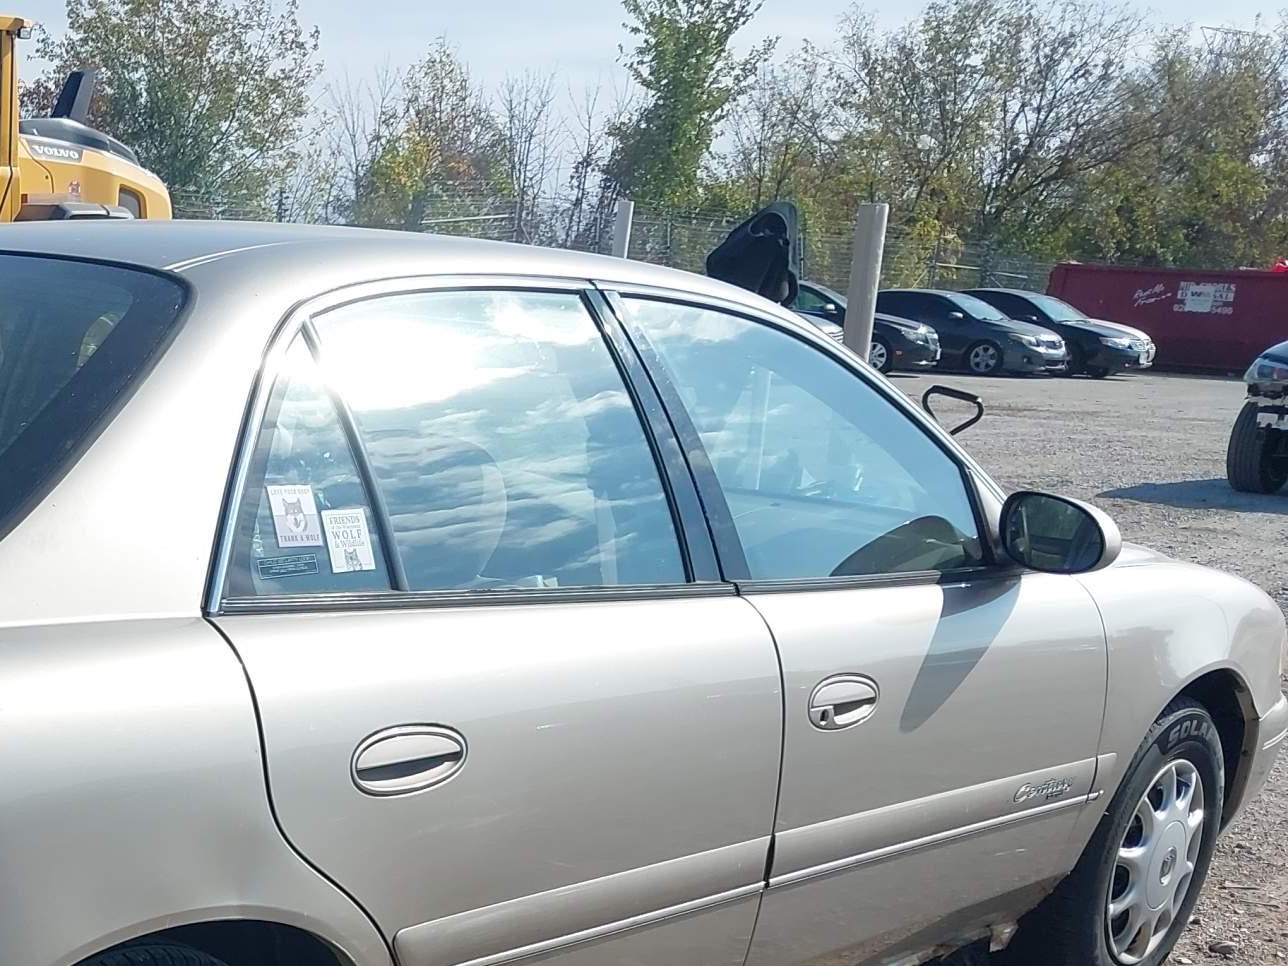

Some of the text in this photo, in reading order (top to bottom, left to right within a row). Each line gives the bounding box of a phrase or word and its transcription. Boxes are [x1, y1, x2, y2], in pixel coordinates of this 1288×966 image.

[32, 145, 79, 159] VOLVO
[329, 515, 361, 524] FRIENDS
[332, 529, 362, 540] WOLF
